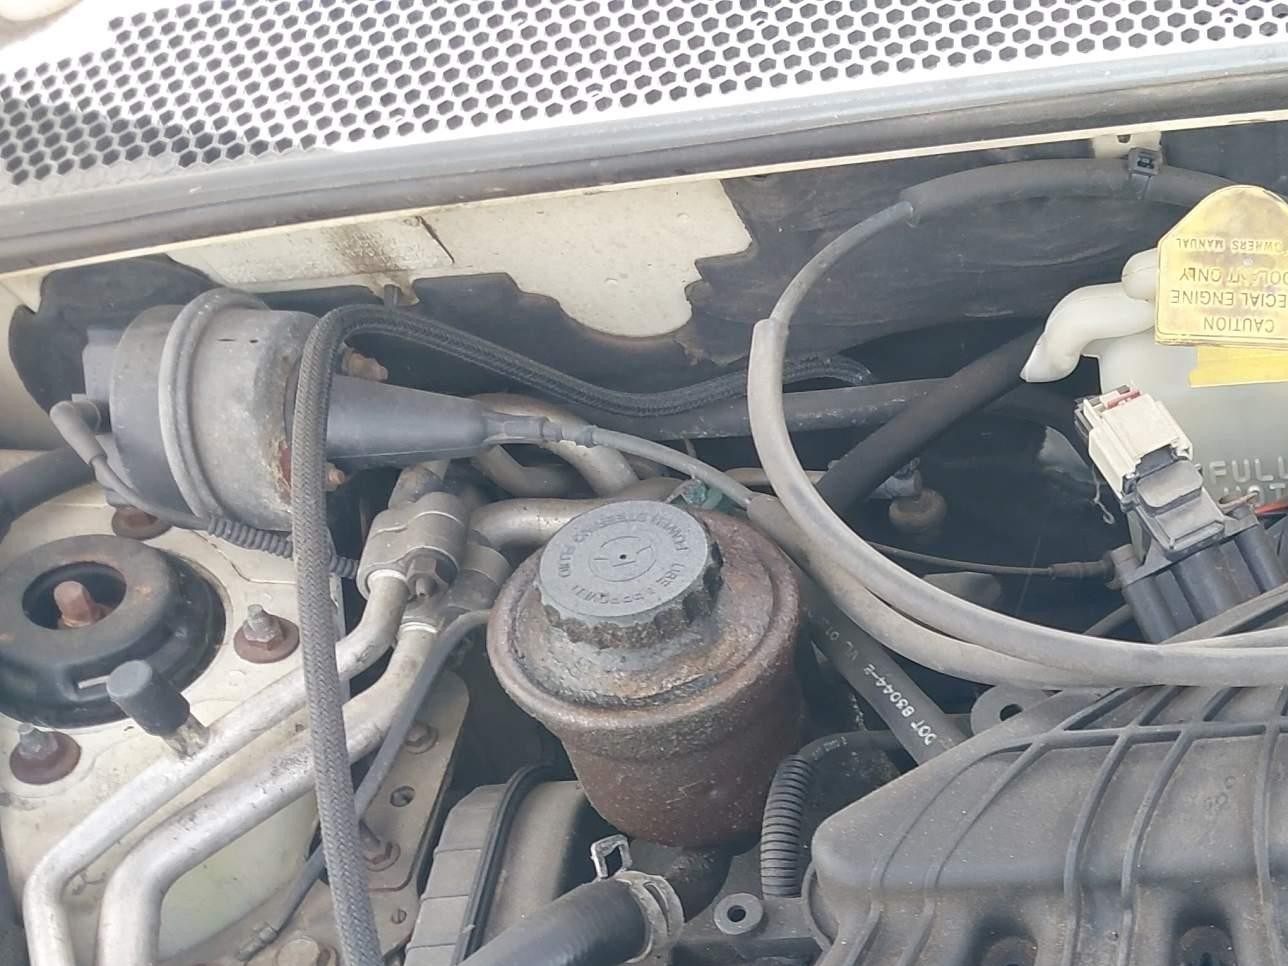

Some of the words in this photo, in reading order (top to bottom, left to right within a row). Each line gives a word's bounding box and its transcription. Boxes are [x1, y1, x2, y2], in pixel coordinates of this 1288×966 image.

[1176, 237, 1225, 250] MANUAL
[1179, 267, 1222, 282] ONLY
[1170, 289, 1234, 306] ENGINE
[1203, 316, 1275, 333] CAUTION
[1223, 483, 1286, 506] OT
[910, 720, 937, 745] DOT
